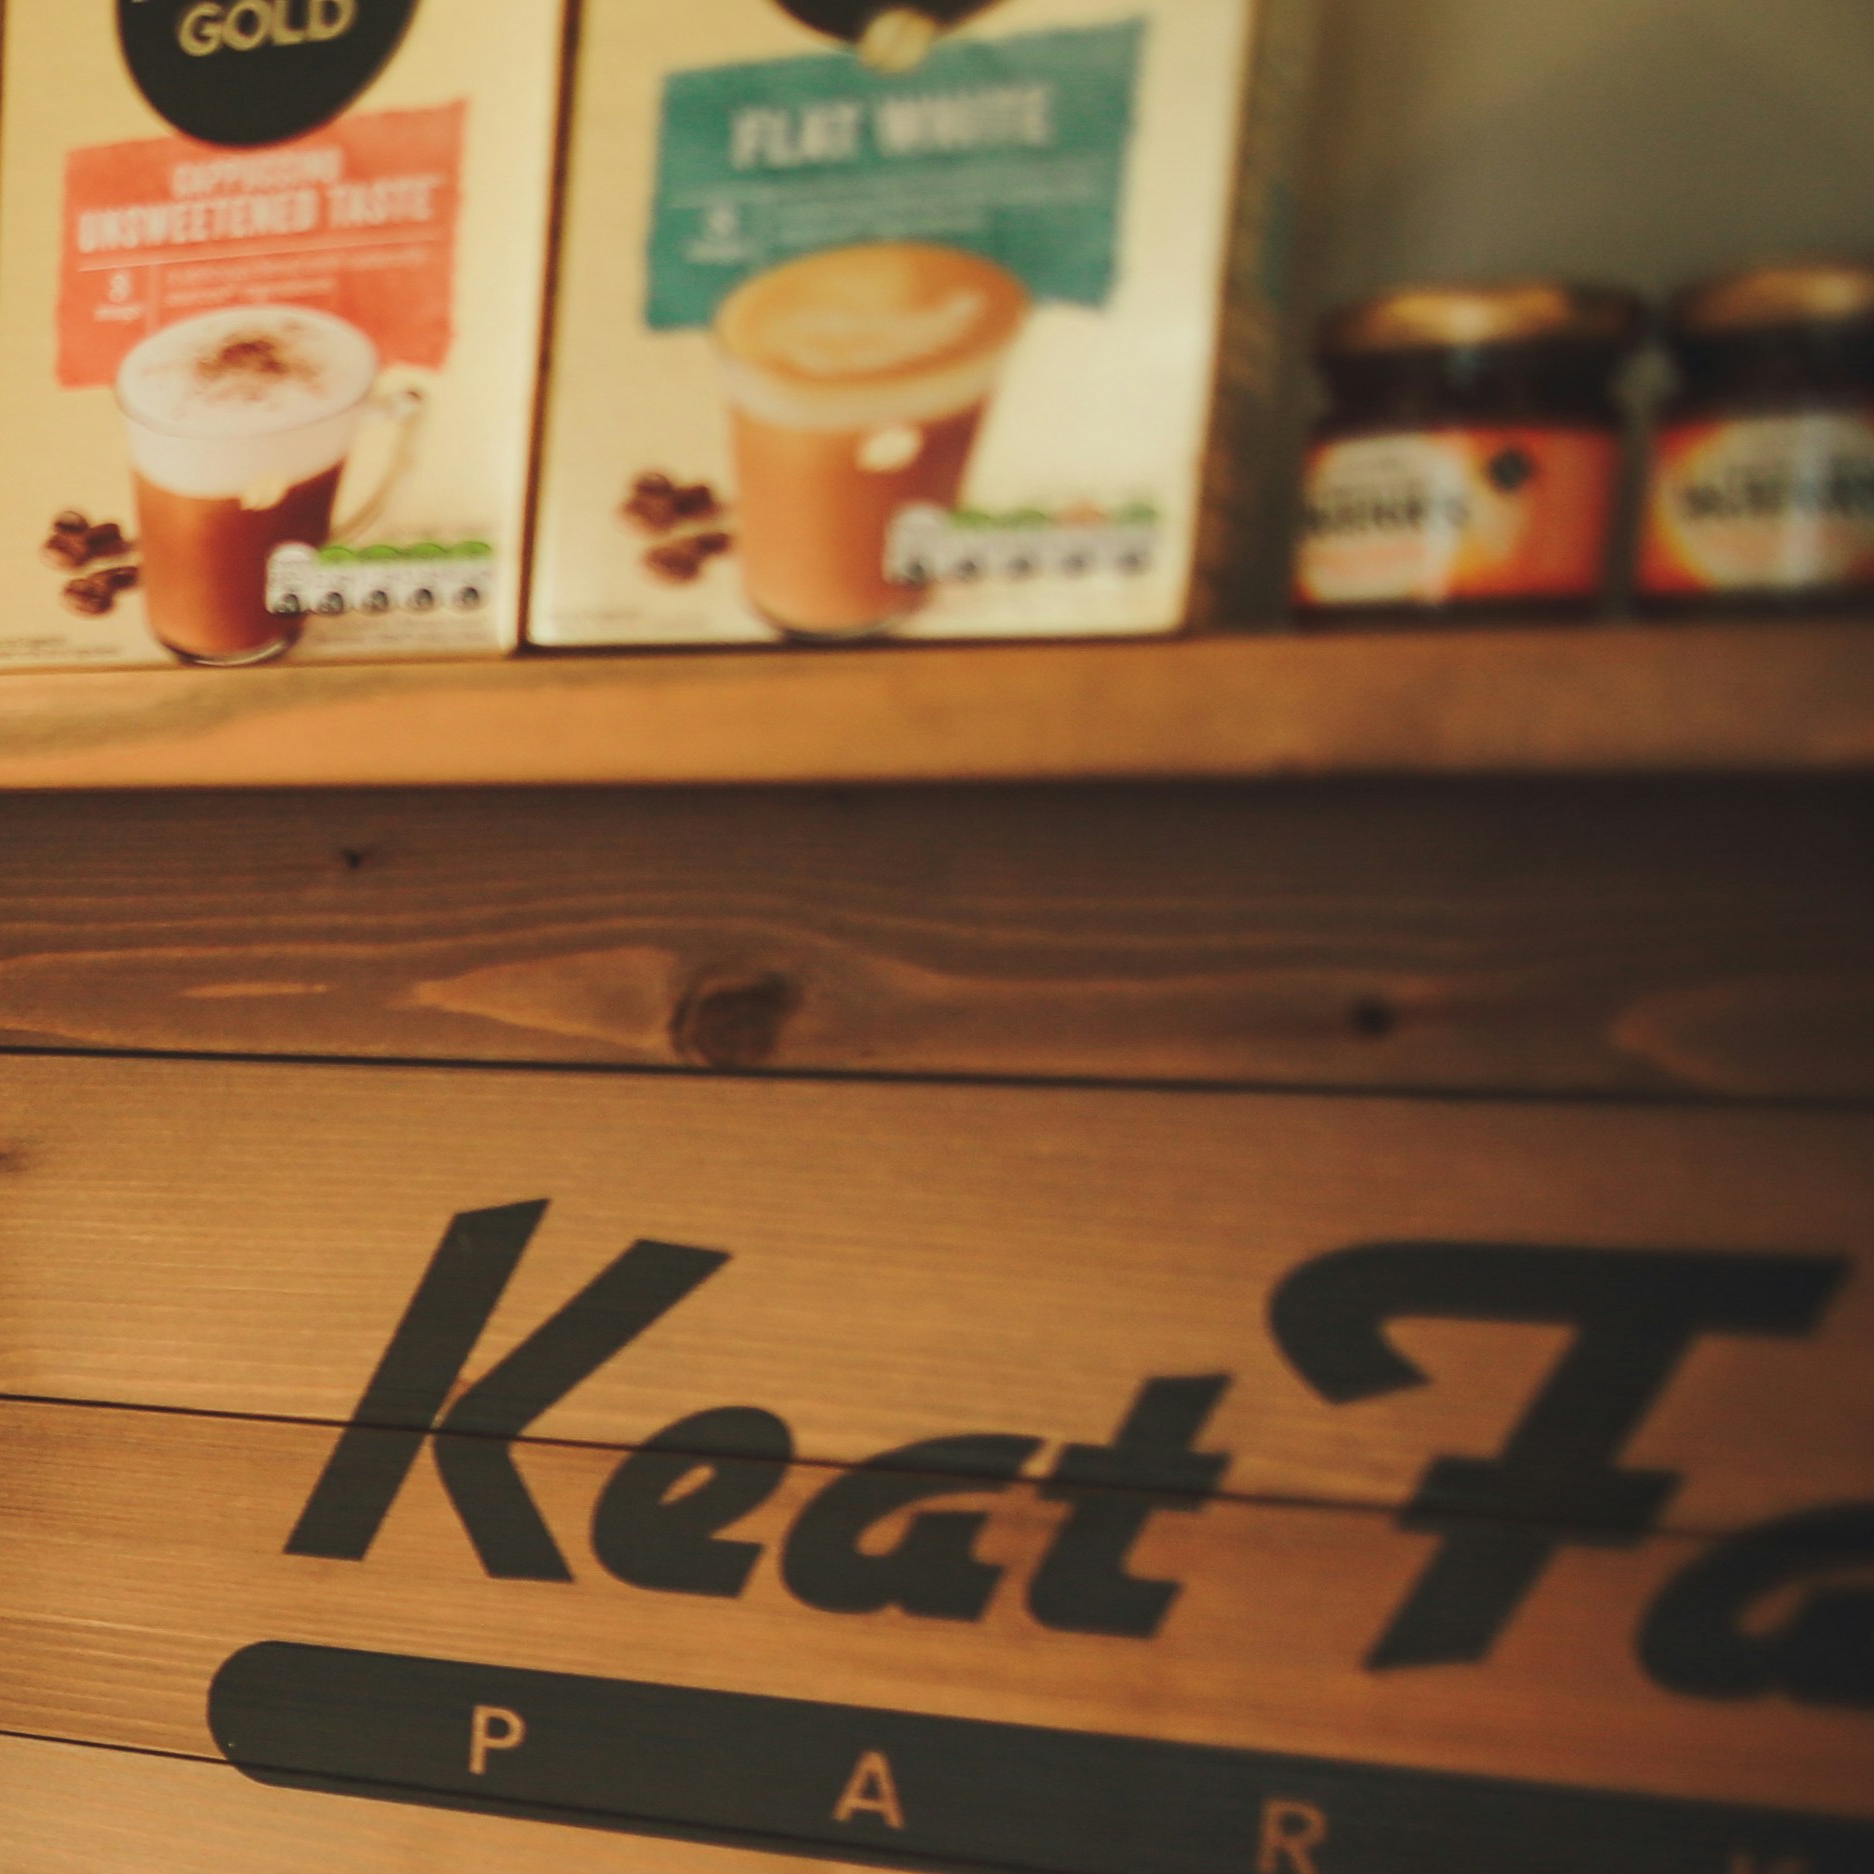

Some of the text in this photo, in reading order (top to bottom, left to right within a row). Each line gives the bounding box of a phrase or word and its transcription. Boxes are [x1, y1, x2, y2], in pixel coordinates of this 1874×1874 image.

[177, 0, 353, 57] GOLD
[77, 172, 446, 253] UNSWEETENED TASTE
[282, 1198, 1874, 1712] Keat Fa
